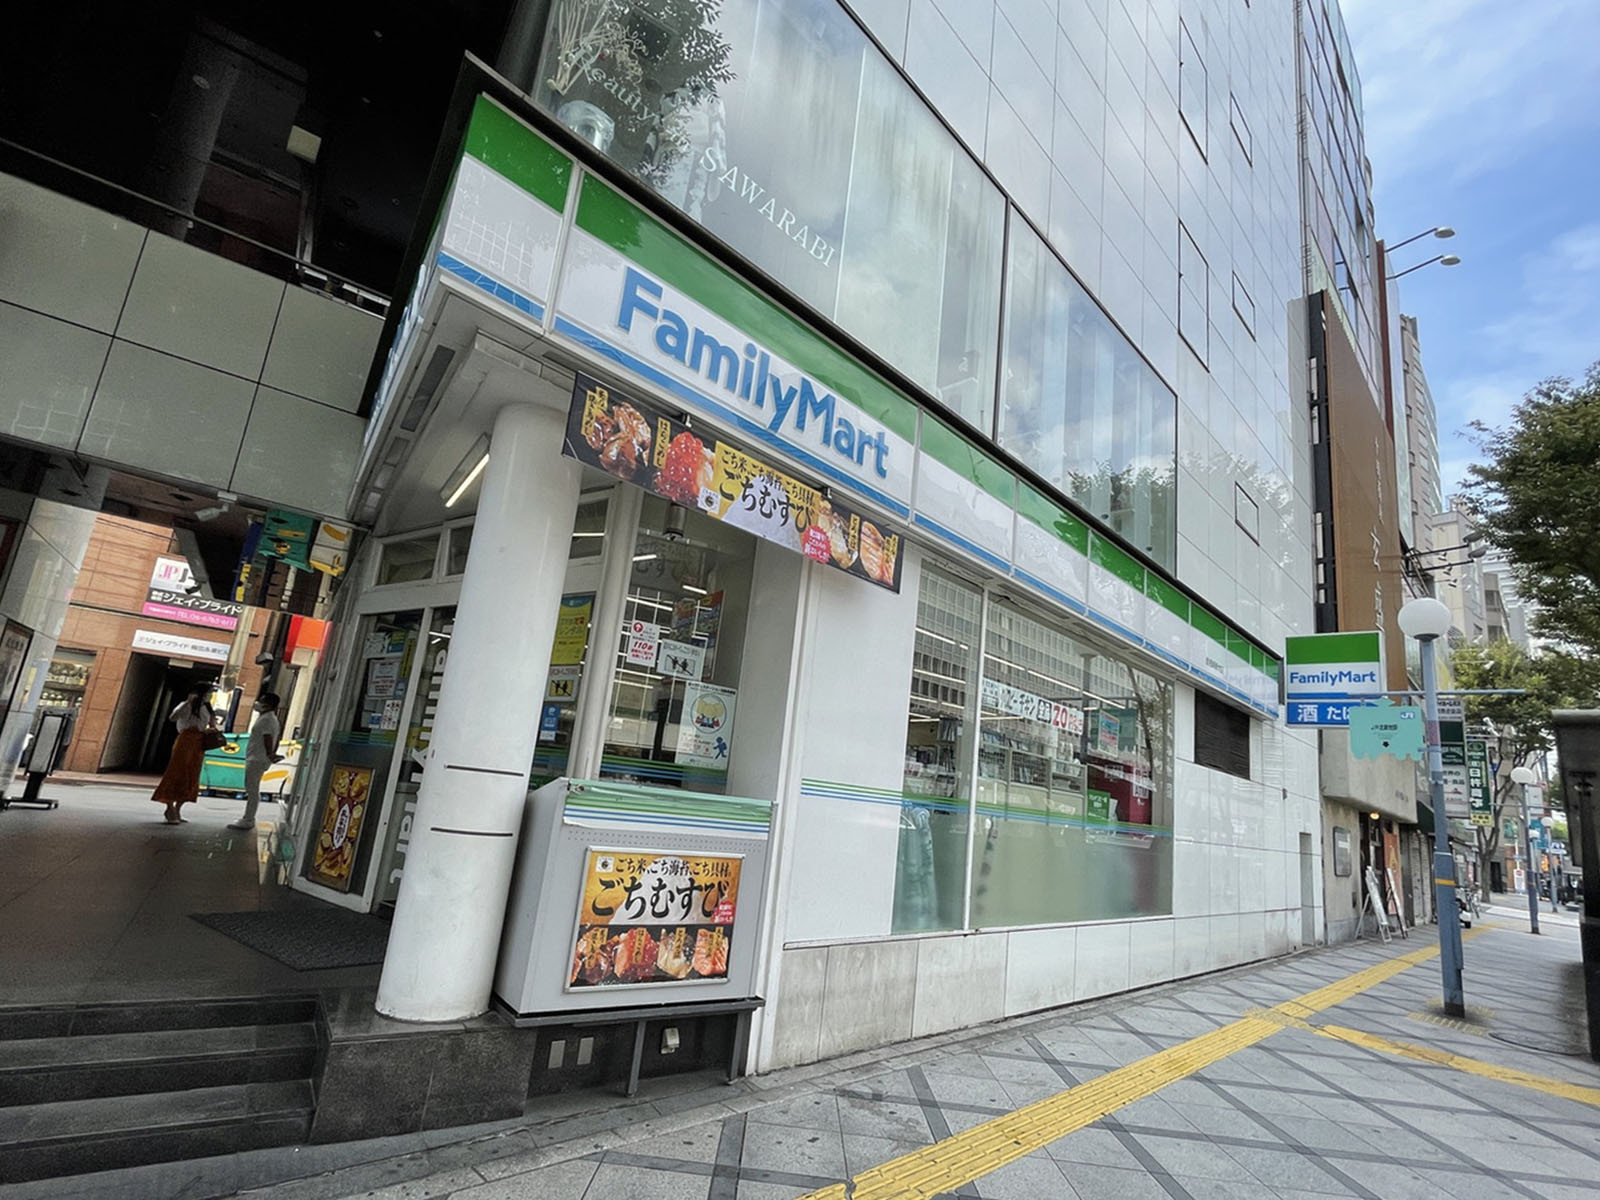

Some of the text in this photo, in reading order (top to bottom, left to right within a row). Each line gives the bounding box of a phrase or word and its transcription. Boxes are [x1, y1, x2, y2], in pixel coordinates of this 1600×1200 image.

[700, 147, 835, 267] SAWARABI
[617, 266, 890, 479] FamilyMart
[719, 467, 816, 534] ごちむすび
[1289, 671, 1376, 687] FamilyMart
[1297, 704, 1318, 723] 酒
[591, 875, 730, 921] ごちむすび
